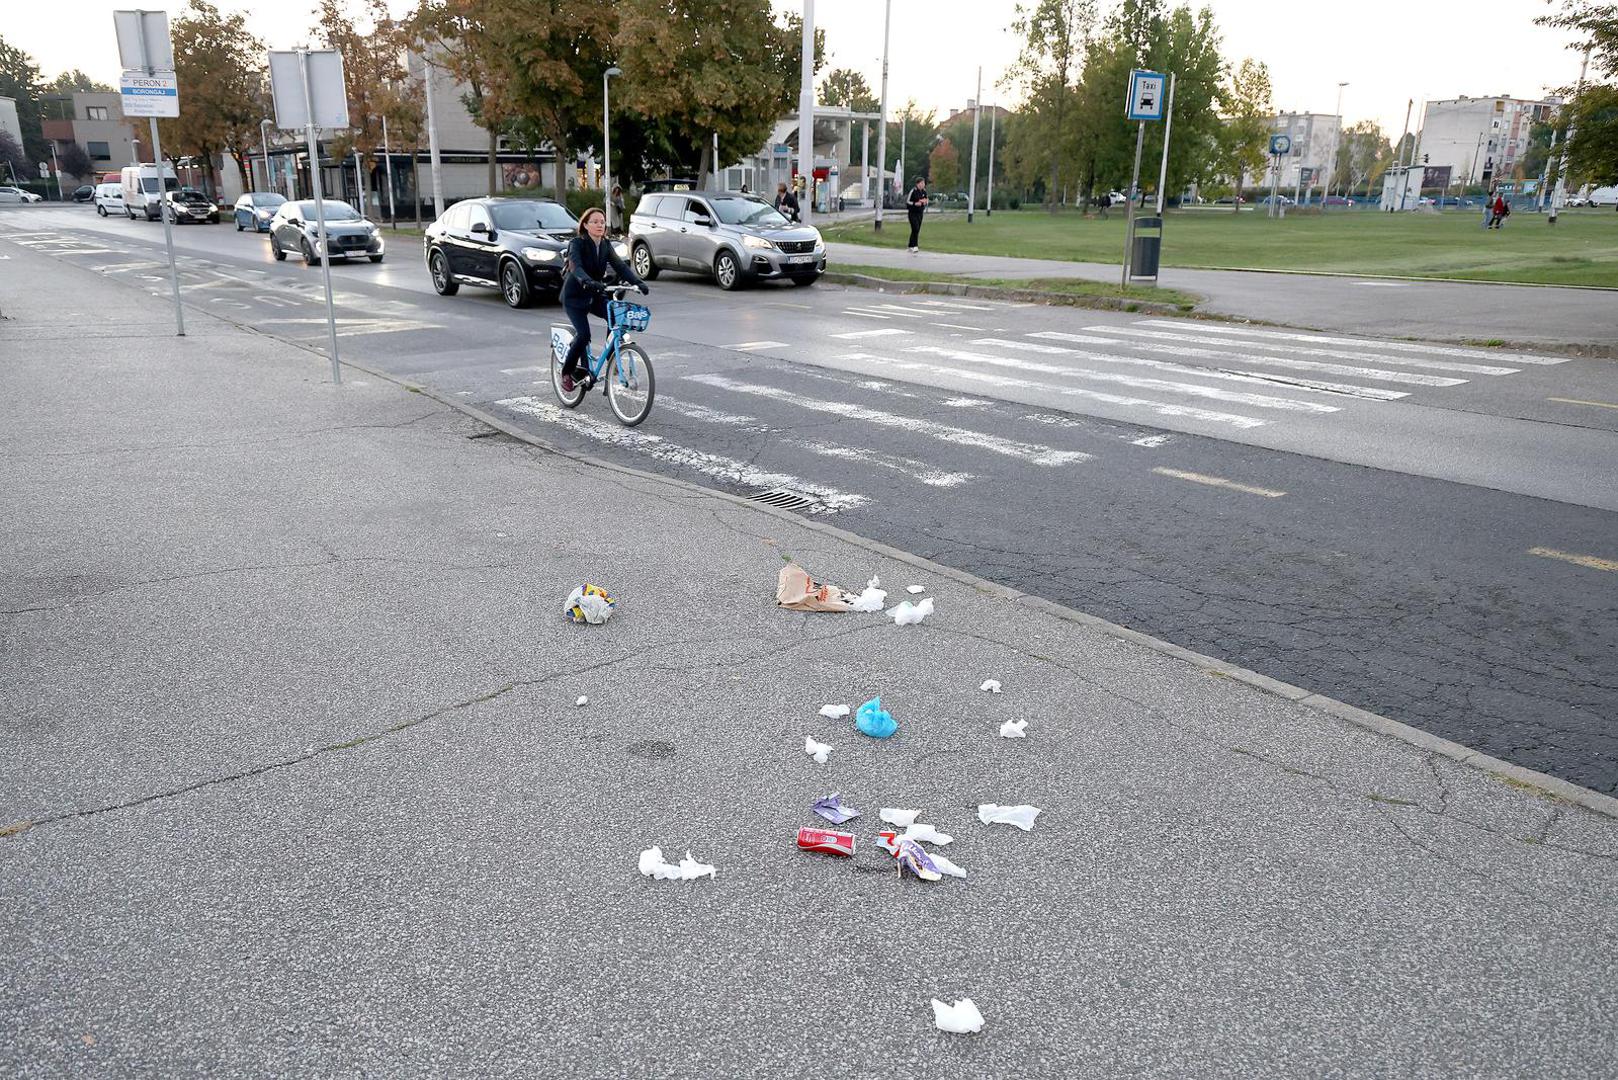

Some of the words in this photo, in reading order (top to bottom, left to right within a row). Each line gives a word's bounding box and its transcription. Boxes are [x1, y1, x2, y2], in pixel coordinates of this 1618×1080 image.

[132, 79, 161, 87] PERON
[1142, 80, 1157, 89] Taxi
[626, 310, 648, 320] Bajs
[552, 333, 568, 360] Baj
